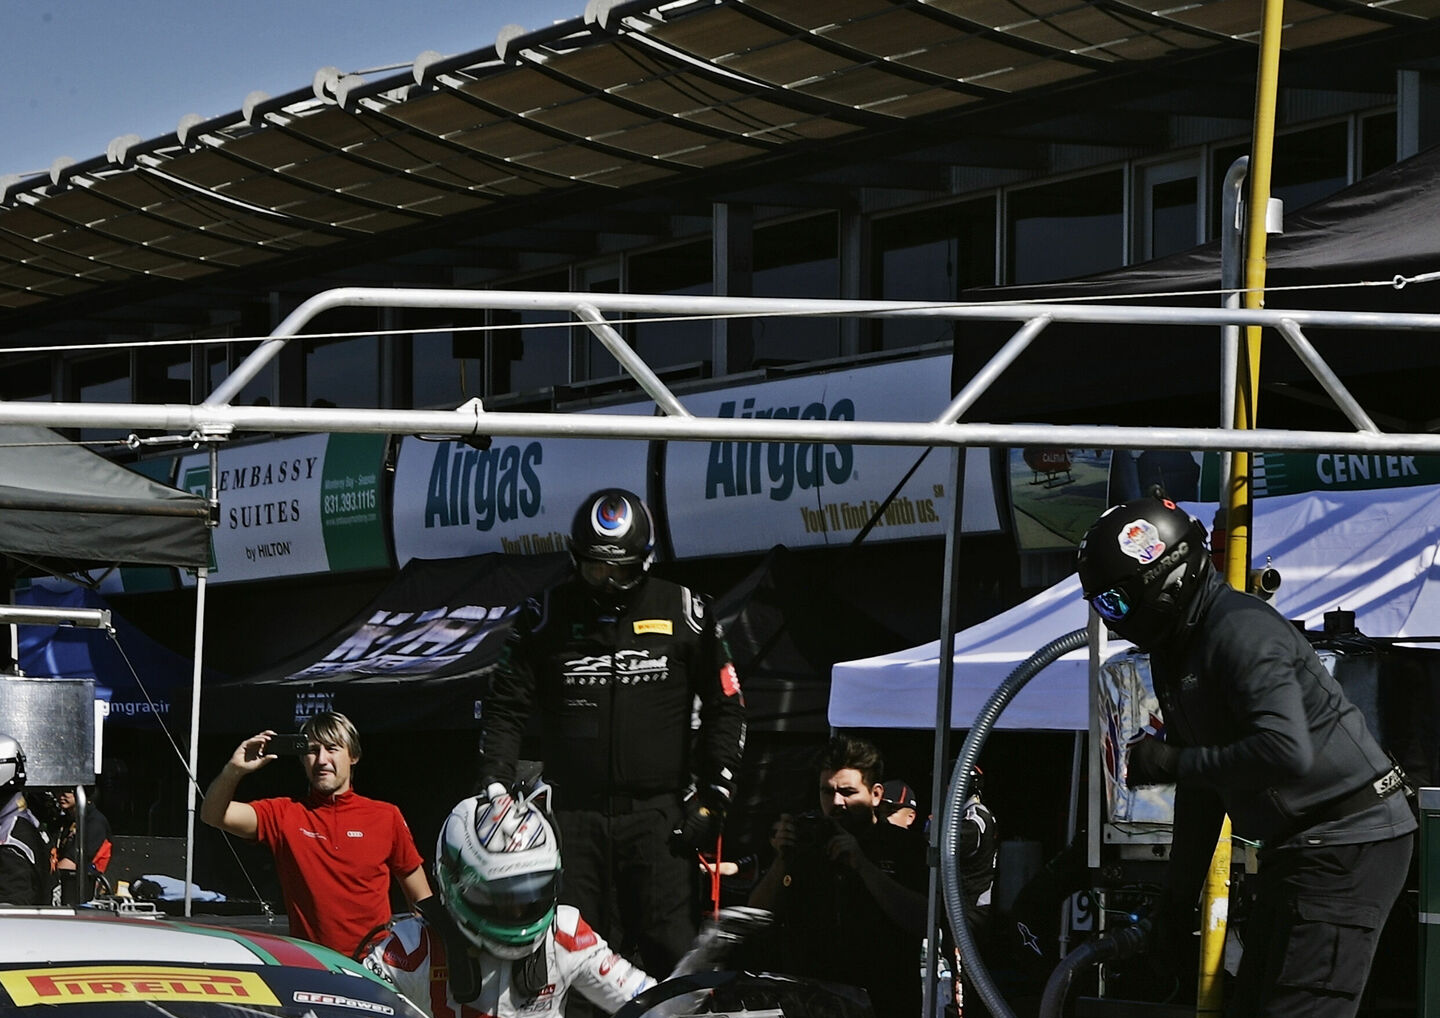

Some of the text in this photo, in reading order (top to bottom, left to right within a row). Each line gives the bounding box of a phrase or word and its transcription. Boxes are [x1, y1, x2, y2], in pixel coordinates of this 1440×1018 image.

[706, 398, 856, 501] Airgas
[219, 456, 318, 491] EMBASSY
[425, 441, 543, 531] Airgas
[229, 499, 300, 529] SUITES
[324, 489, 376, 514] 831.393.1115
[885, 496, 917, 526] with
[246, 542, 291, 562] by HILTON
[26, 971, 251, 998] PIRELLI
